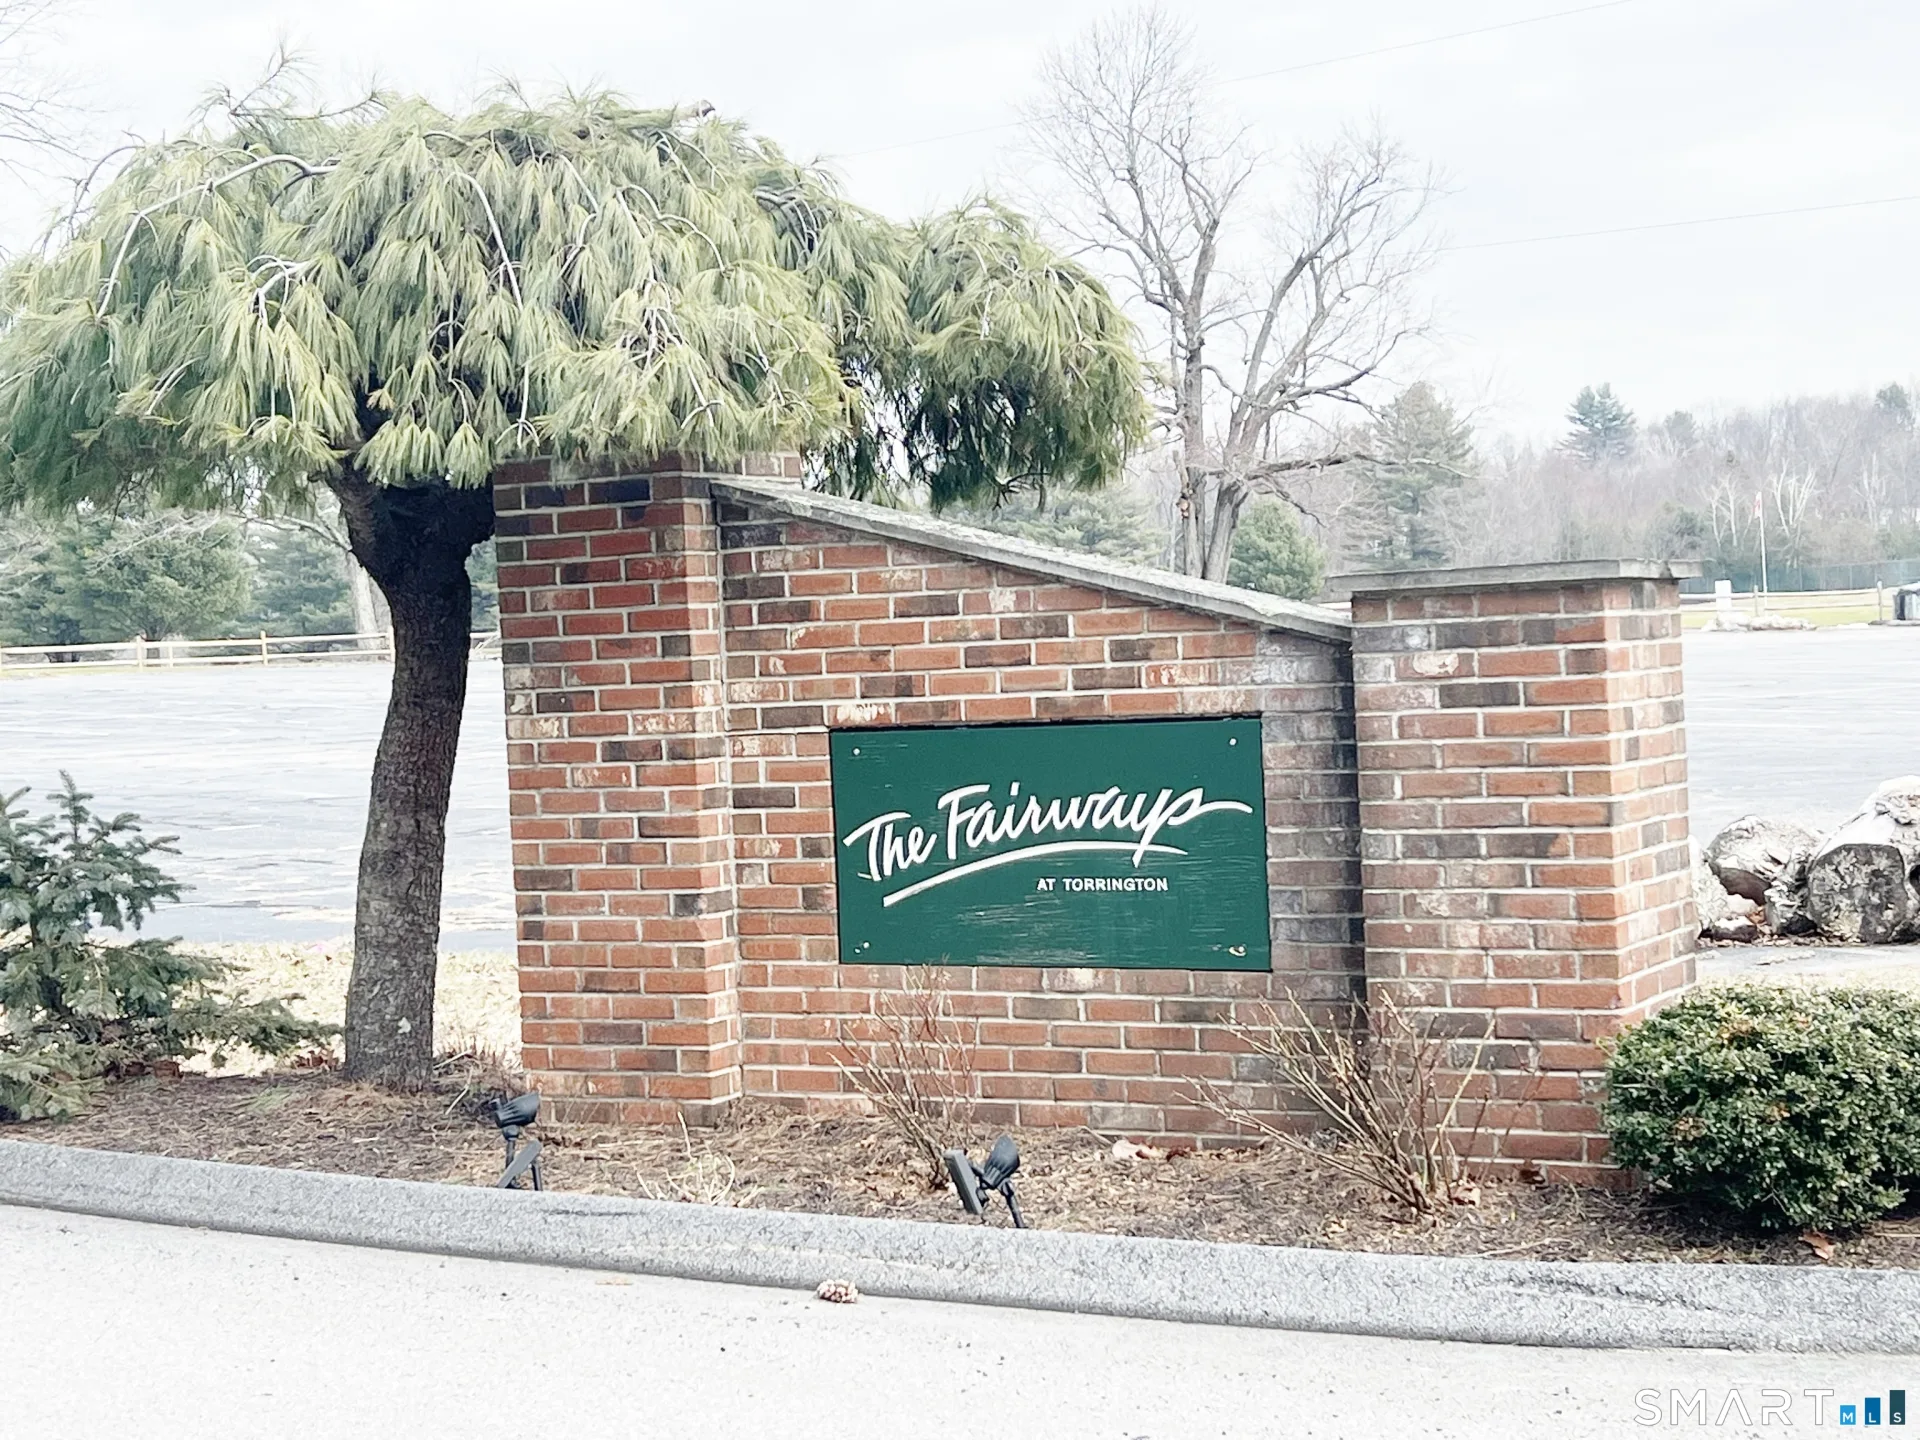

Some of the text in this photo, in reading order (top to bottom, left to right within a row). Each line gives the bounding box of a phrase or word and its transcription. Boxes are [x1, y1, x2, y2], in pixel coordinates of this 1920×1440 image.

[843, 782, 1253, 881] The Fairways
[1036, 877, 1168, 892] AT TORRINGTON
